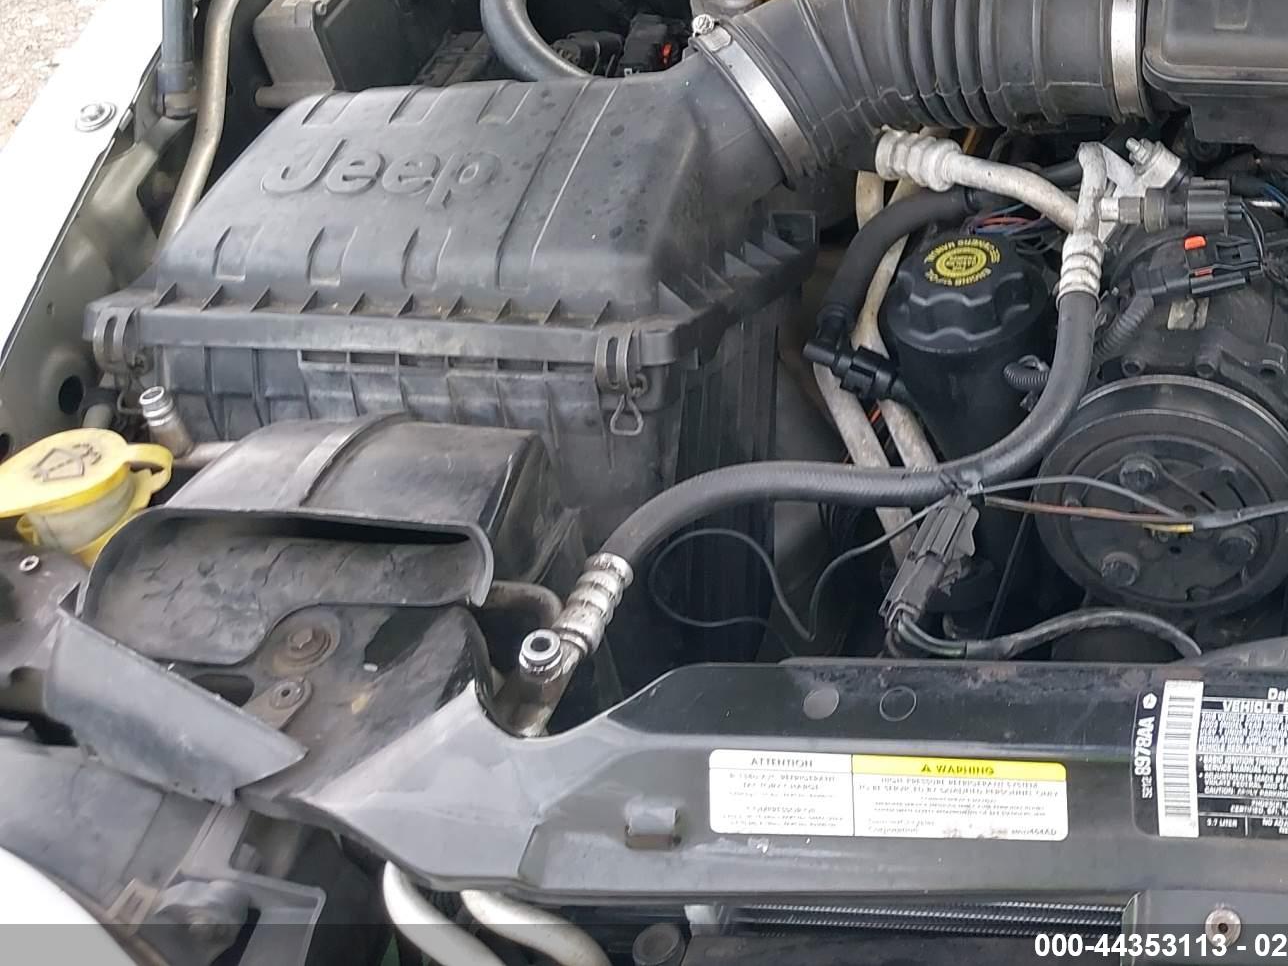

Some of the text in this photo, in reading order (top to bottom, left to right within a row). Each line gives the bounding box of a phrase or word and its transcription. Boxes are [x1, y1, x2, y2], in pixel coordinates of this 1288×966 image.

[261, 138, 500, 209] Jeep
[1223, 701, 1279, 713] VEHICLE
[752, 758, 813, 767] ATTENTION
[936, 764, 995, 775] WARNING
